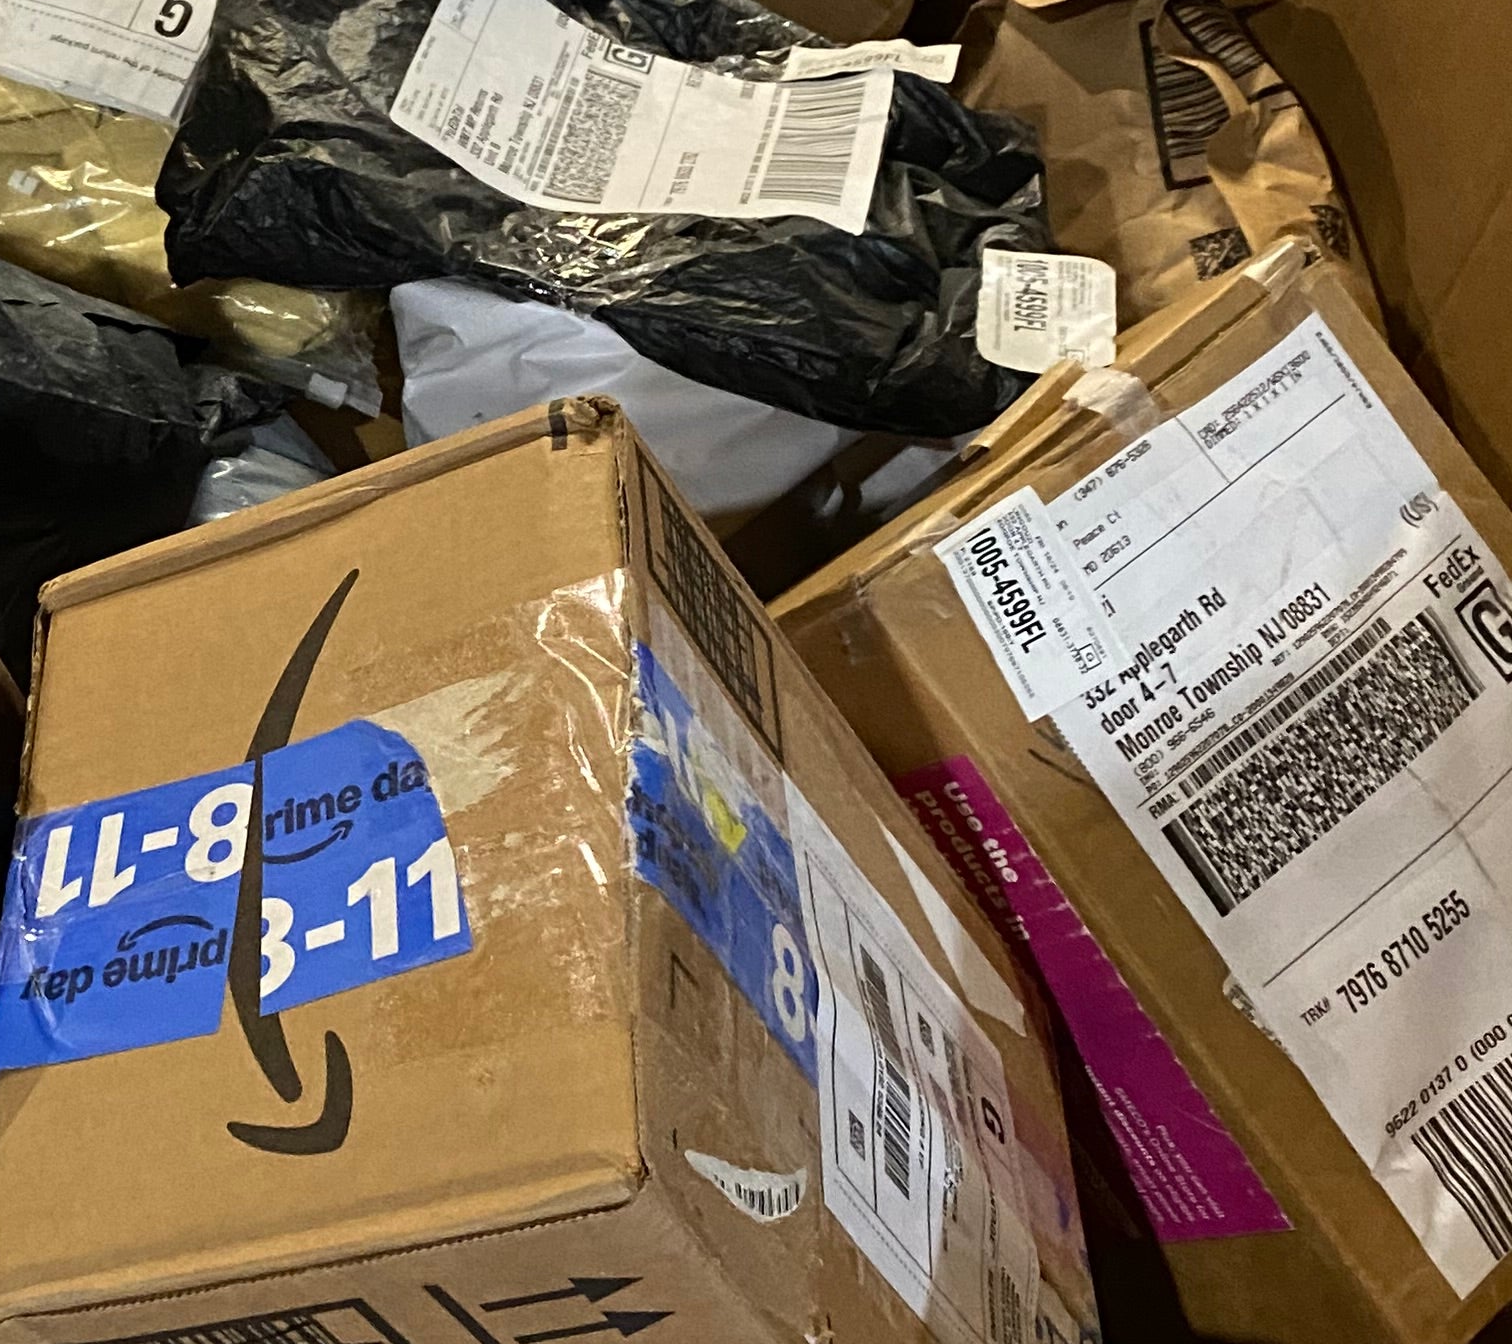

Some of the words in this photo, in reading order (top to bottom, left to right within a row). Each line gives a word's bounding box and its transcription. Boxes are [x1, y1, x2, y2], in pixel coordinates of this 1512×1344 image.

[89, 45, 121, 62] return
[138, 61, 151, 72] of
[1013, 257, 1047, 334] 1005-4599FL
[1070, 472, 1106, 504] (347)
[1397, 487, 1441, 531] (US)
[1072, 521, 1107, 551] Peace
[1105, 508, 1122, 526] Ct
[1098, 533, 1133, 564] 20613
[963, 526, 1051, 654] 1005-4599FL
[1421, 540, 1483, 600] FedEx
[1197, 584, 1227, 617] Rd
[1115, 697, 1184, 763] Monroe
[1177, 636, 1265, 713] Township
[1257, 617, 1287, 651] NJ
[1278, 580, 1332, 633] 08831
[1095, 691, 1142, 737] door
[1130, 746, 1166, 779] (800)
[265, 784, 363, 841] rime
[940, 778, 986, 835] Use
[979, 834, 1023, 887] the
[1147, 789, 1181, 820] RMA:
[35, 783, 254, 918] 8-11
[914, 785, 1012, 913] products
[1005, 912, 1034, 944] in
[19, 963, 94, 1006] day
[104, 926, 228, 988] prime
[1299, 995, 1334, 1029] TRK#
[1335, 959, 1389, 1016] 7976
[1378, 923, 1432, 980] 8710
[1421, 887, 1473, 944] 5255
[1385, 1100, 1419, 1136] 9622
[1419, 1065, 1453, 1105] 0137
[1454, 1055, 1468, 1072] 0
[1470, 1025, 1507, 1062] (000
[1083, 1063, 1116, 1107] instant
[1112, 1107, 1156, 1168] discounts
[1147, 1136, 1177, 1174] Online
[1173, 1173, 1198, 1204] Store
[1172, 1152, 1193, 1176] you
[1188, 1173, 1207, 1196] can
